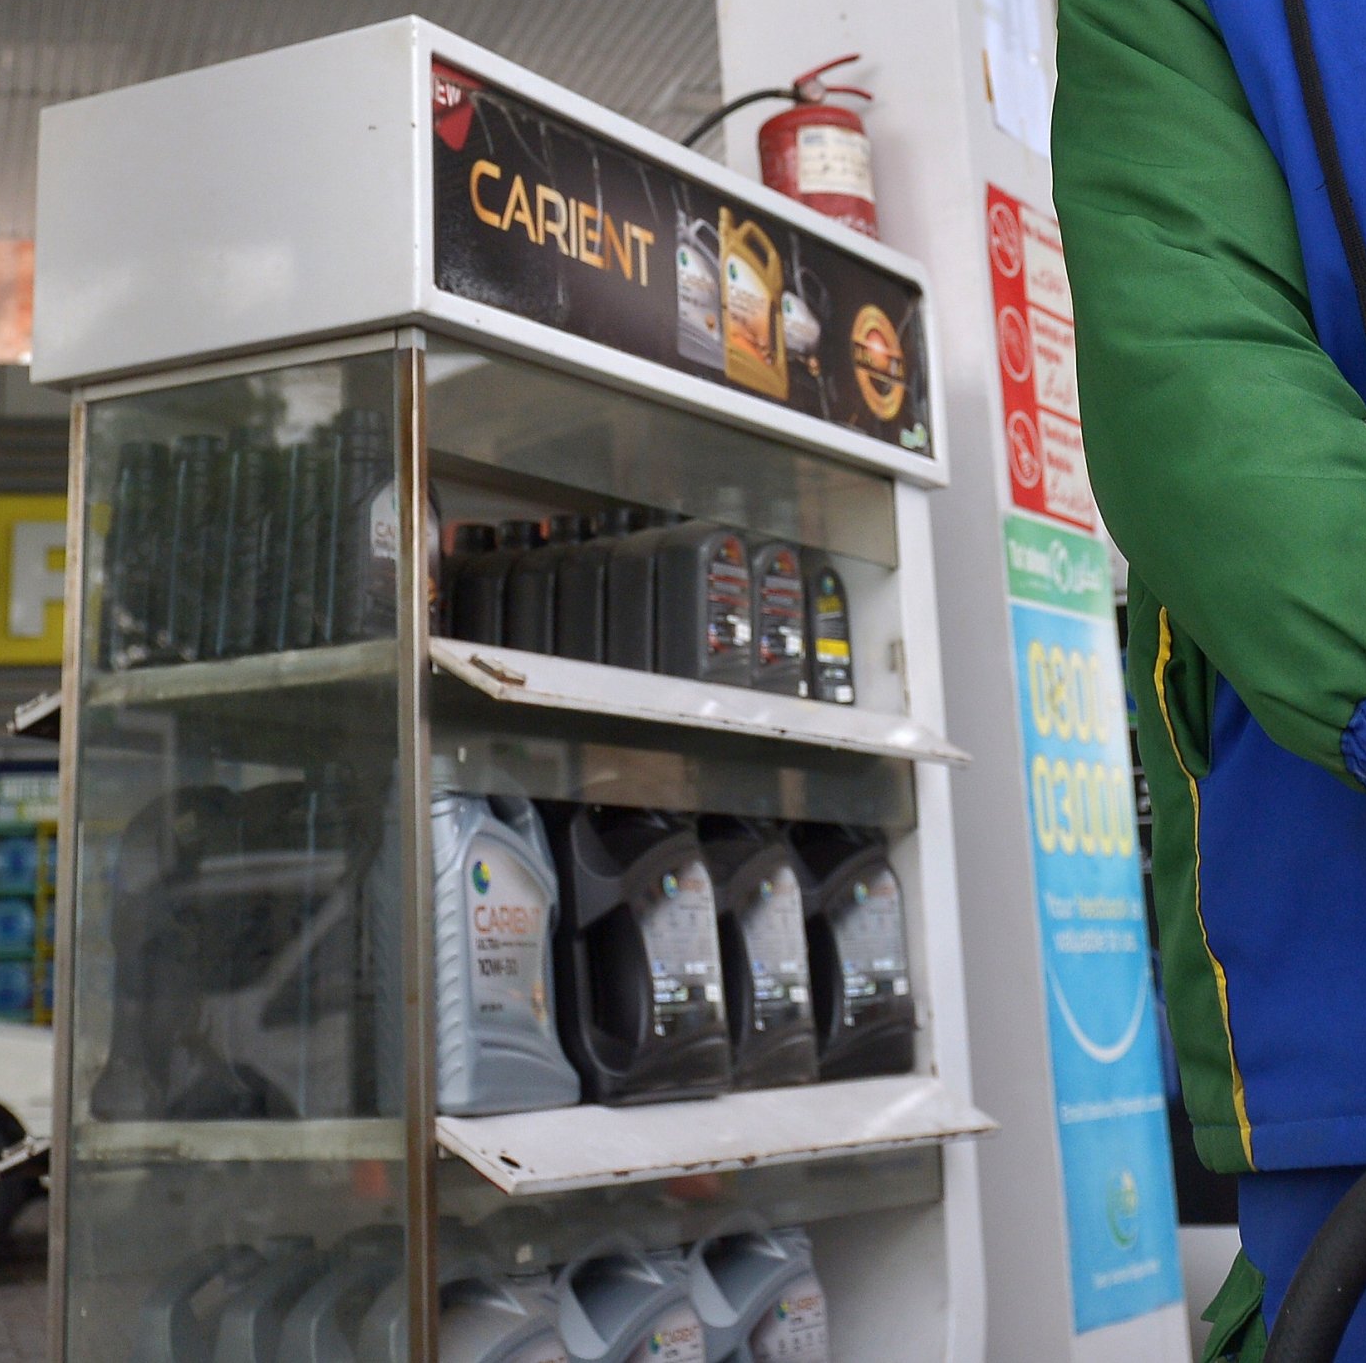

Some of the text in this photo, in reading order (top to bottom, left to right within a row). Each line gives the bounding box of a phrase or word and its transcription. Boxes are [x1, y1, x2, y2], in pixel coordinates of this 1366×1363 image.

[435, 77, 462, 107] EW
[470, 159, 655, 287] CARIENT
[1032, 754, 1134, 858] 03000
